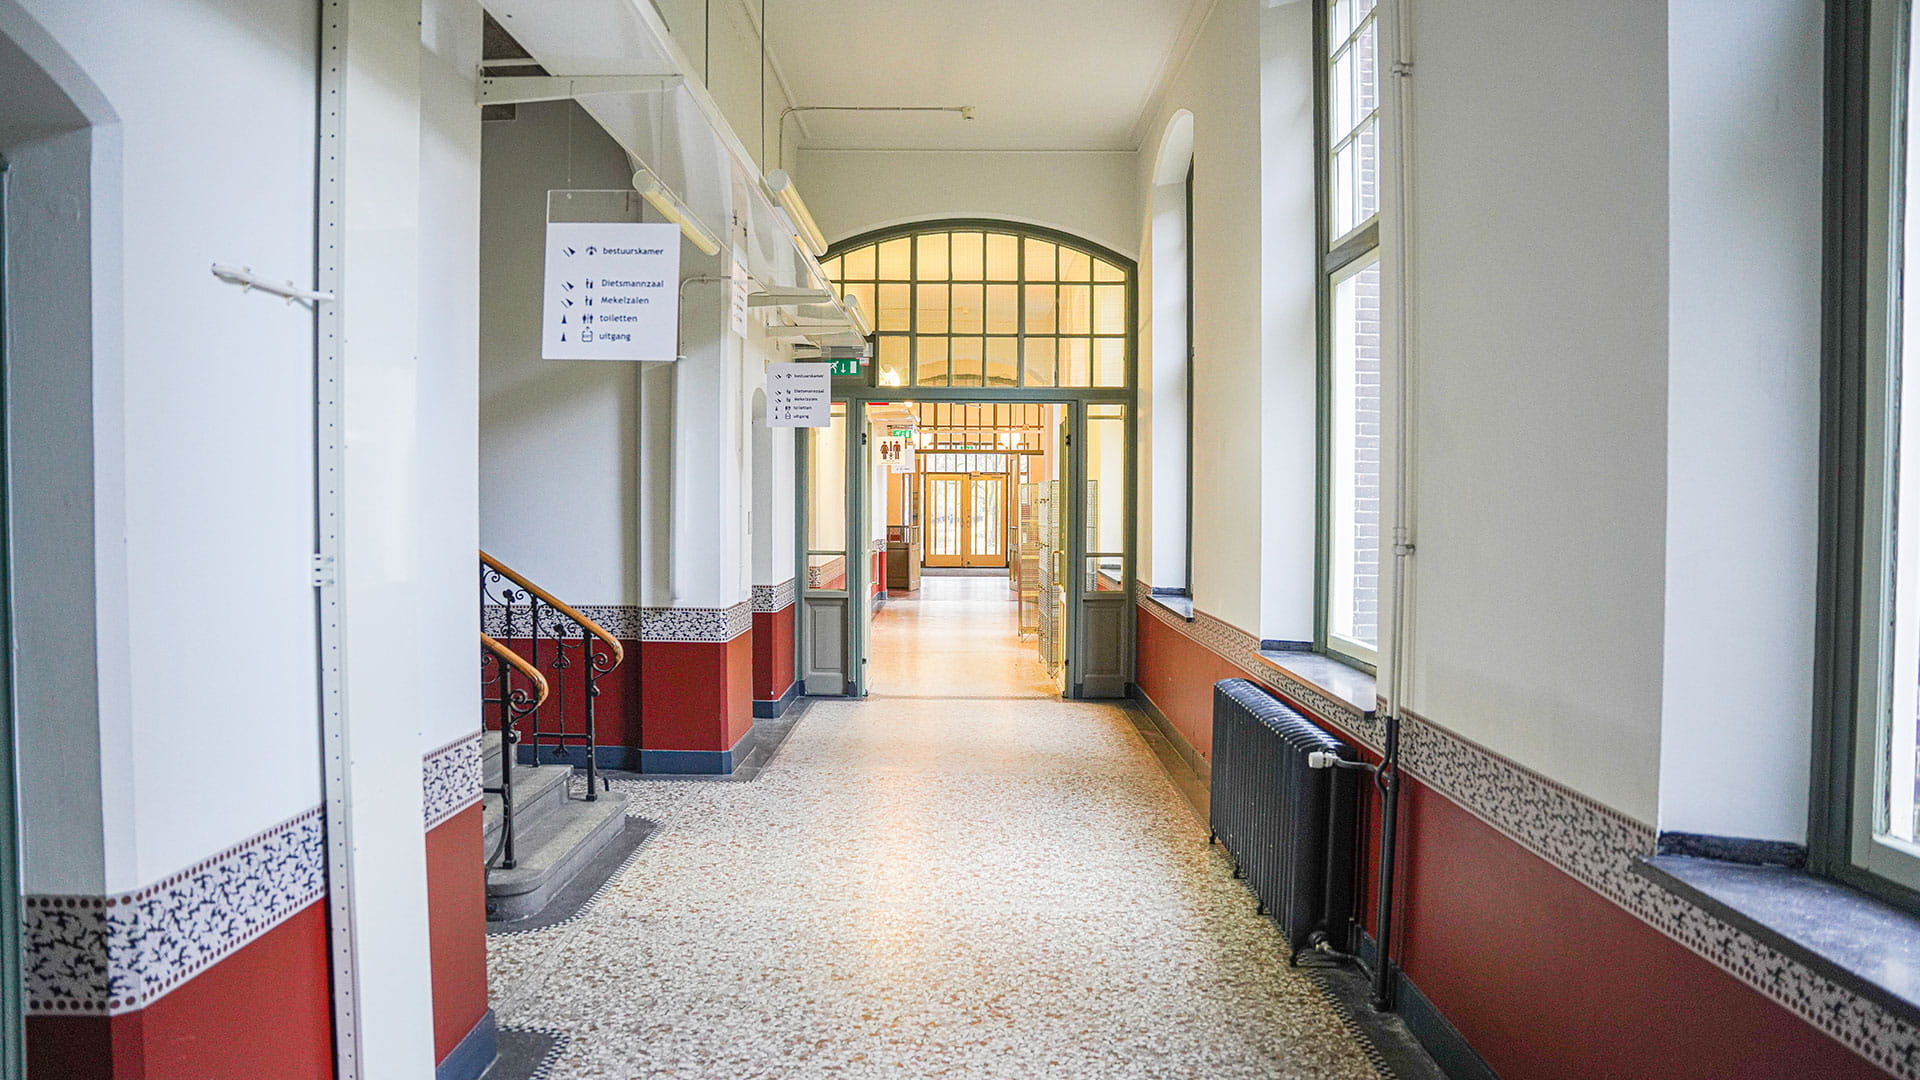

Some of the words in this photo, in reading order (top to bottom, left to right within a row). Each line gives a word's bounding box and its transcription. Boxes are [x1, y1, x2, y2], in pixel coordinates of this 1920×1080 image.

[602, 247, 664, 255] bestuurskamer
[601, 278, 664, 288] Dietsmannzaal
[600, 296, 650, 304] Mekelzalen
[599, 314, 638, 322] toiletten
[598, 332, 631, 342] uitgang
